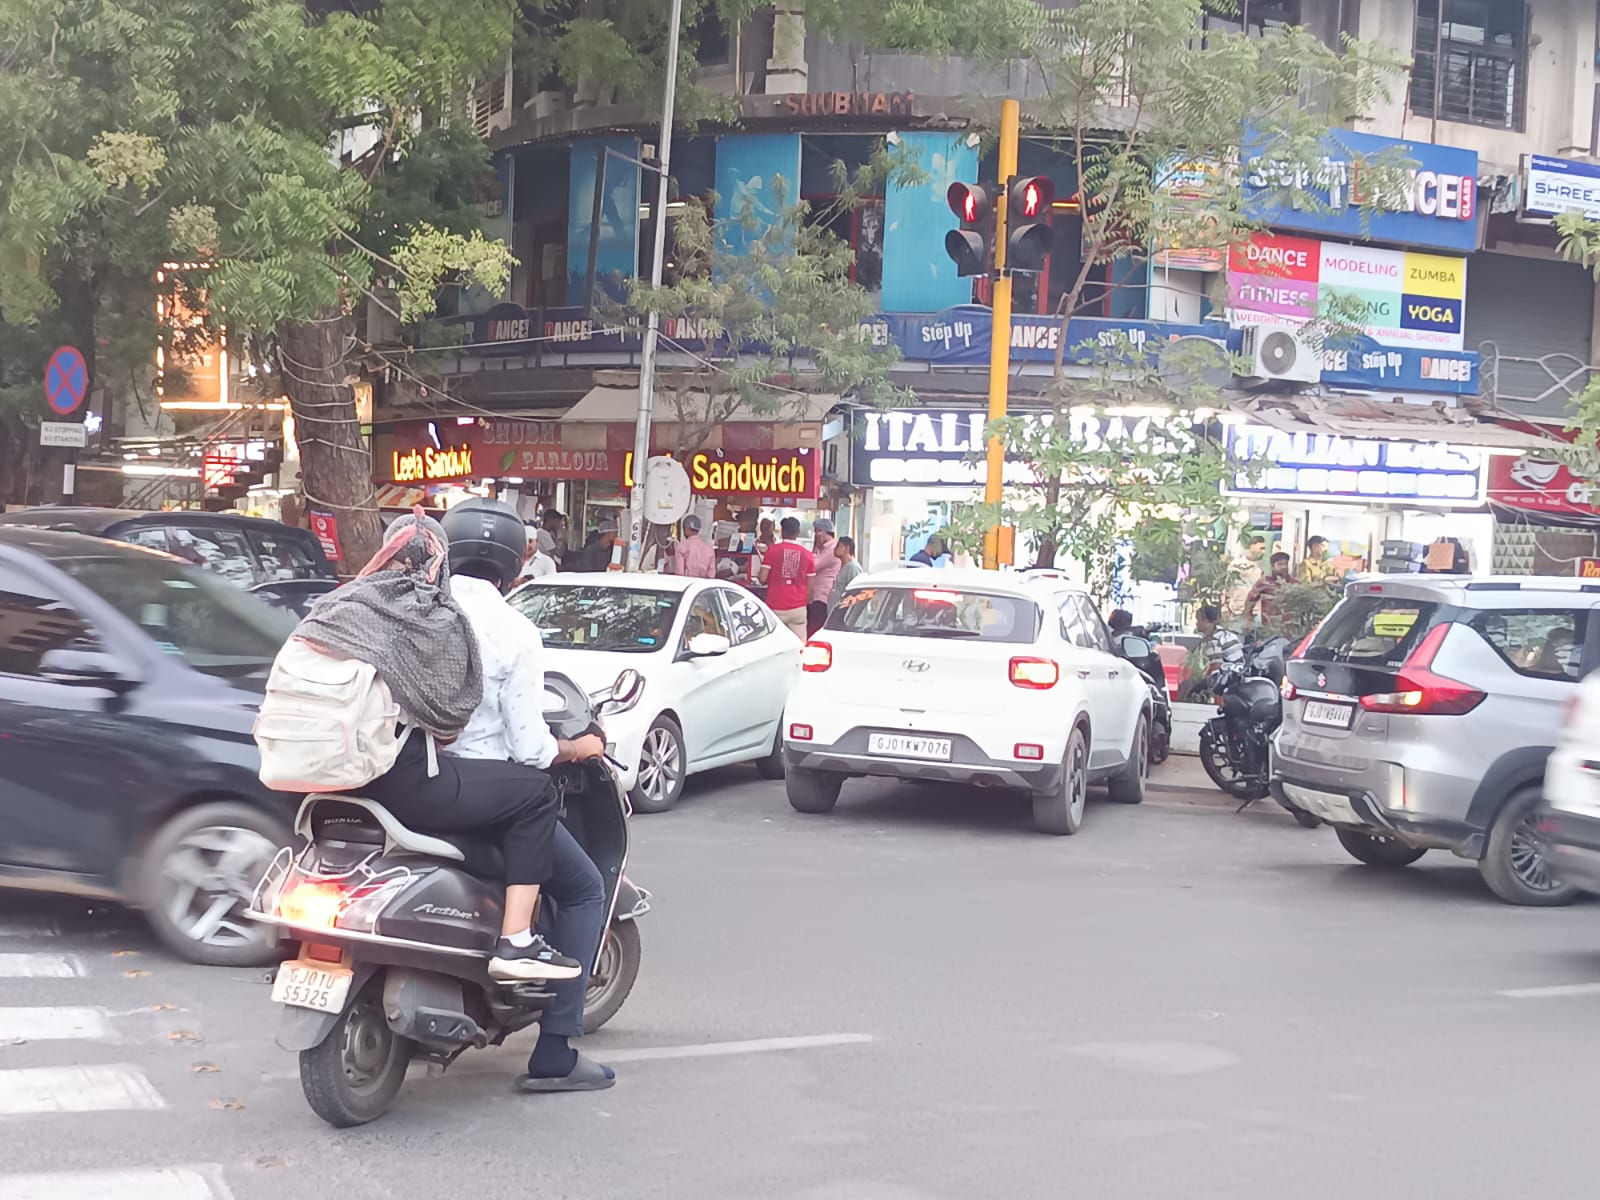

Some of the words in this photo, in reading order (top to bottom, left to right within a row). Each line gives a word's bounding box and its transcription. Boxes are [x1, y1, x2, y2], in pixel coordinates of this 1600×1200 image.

[1246, 245, 1307, 267] DANCE
[1325, 257, 1398, 278] MODELING
[1409, 267, 1456, 284] ZUMBA
[1239, 284, 1309, 306] FITNESS
[1407, 303, 1455, 324] YOGA
[921, 325, 952, 350] Step
[954, 321, 973, 347] Up
[1010, 325, 1060, 349] ANCE
[1361, 352, 1387, 379] Step
[1388, 351, 1403, 377] Up
[1420, 356, 1471, 382] DANCE
[521, 450, 609, 471] PARLOUR
[692, 454, 806, 493] Sandwich
